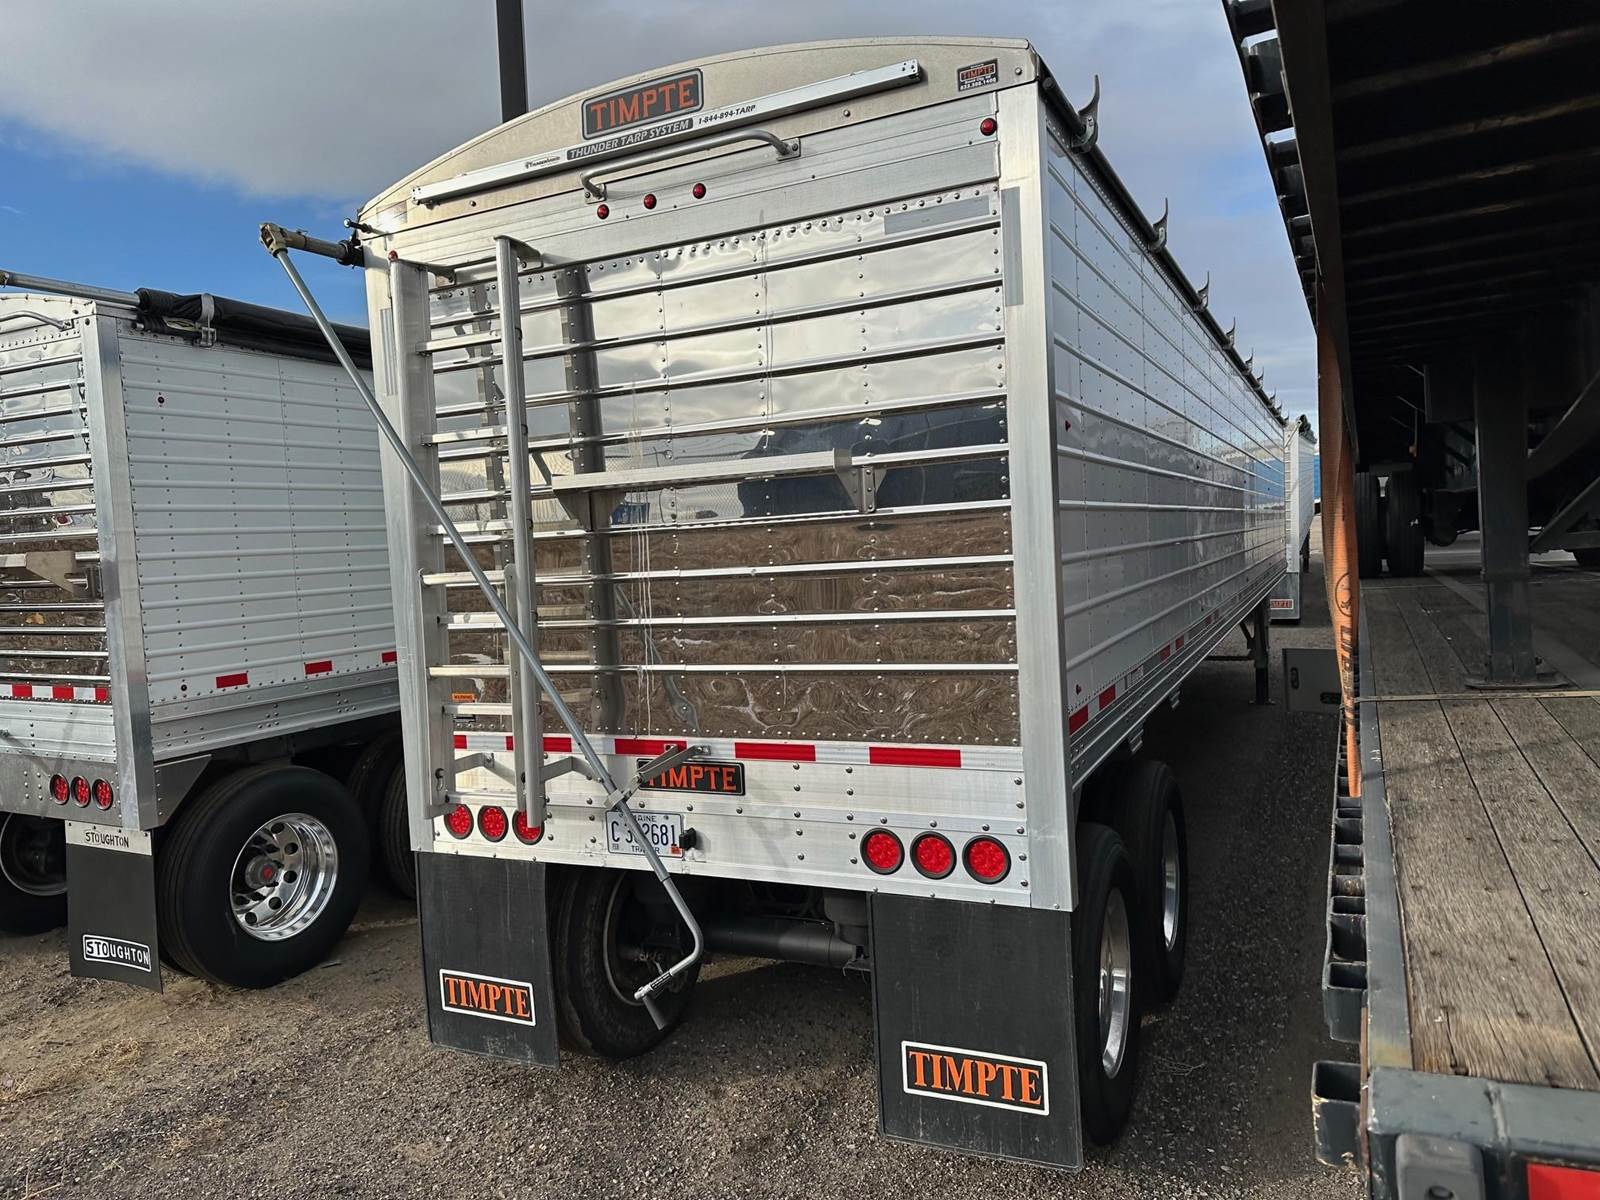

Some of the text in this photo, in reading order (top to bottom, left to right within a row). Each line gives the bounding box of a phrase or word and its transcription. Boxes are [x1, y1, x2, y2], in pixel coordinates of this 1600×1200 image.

[591, 79, 694, 130] TIMPTE
[570, 120, 690, 159] THUNDER TARP SYSTEM
[86, 832, 129, 848] STOUGHTON
[86, 939, 149, 965] STOUGHTON
[444, 977, 530, 1017] TIMPTE
[909, 1051, 1041, 1105] TIMPTE
